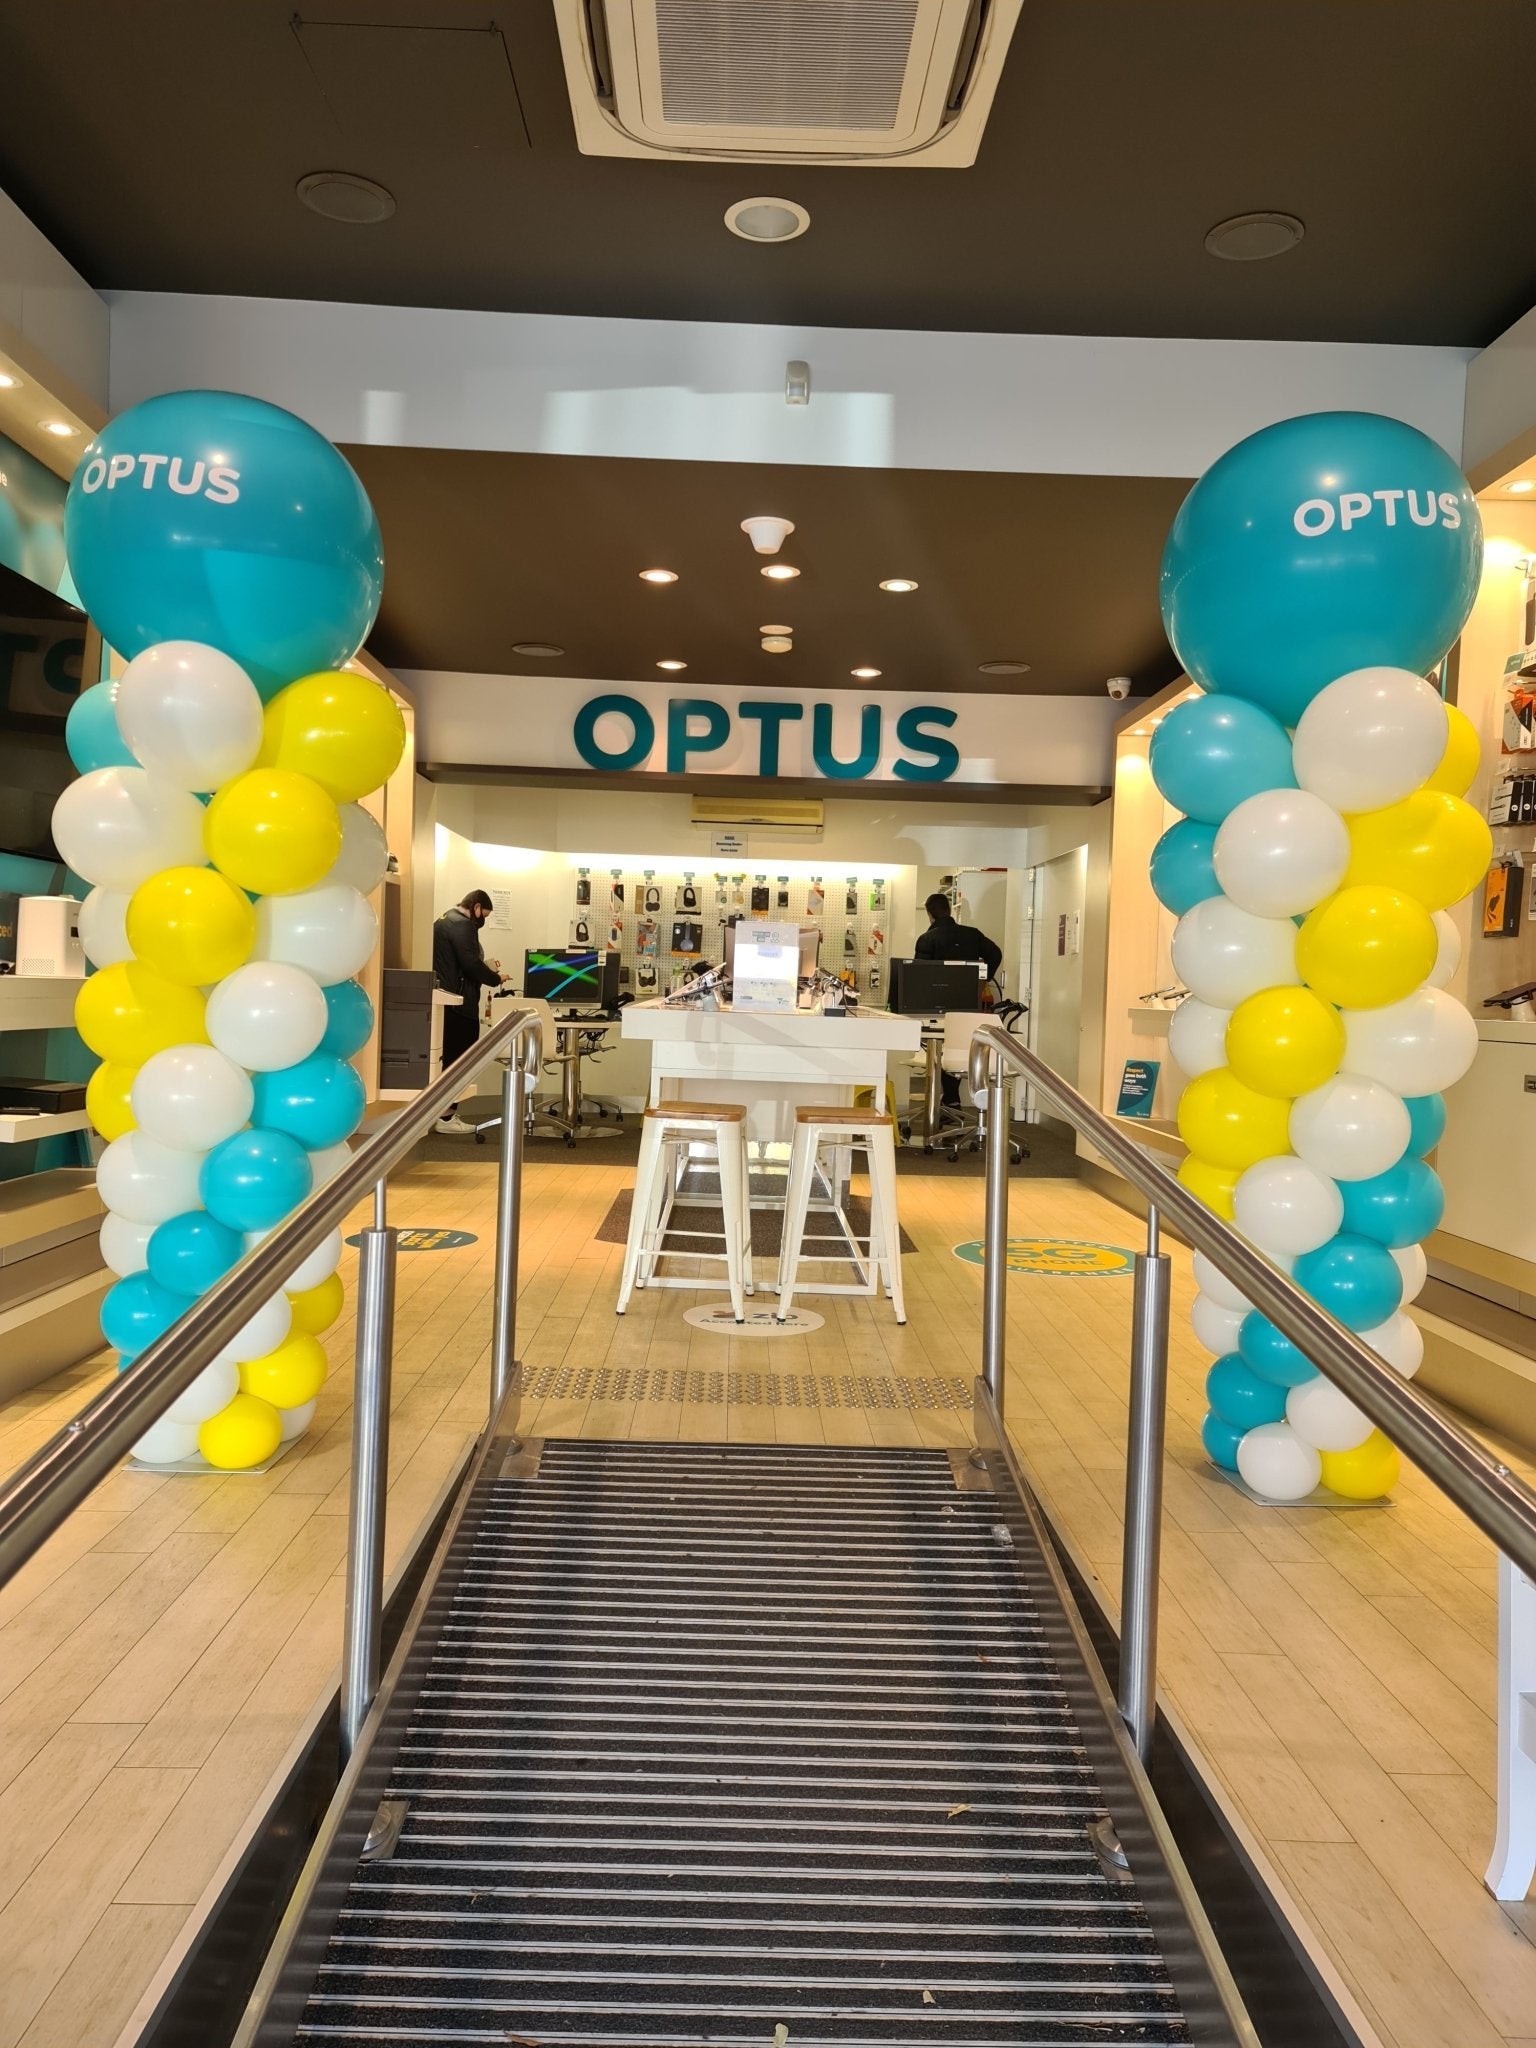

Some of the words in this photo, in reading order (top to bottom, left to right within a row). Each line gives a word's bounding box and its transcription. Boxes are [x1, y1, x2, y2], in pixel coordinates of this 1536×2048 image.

[82, 454, 240, 505] OPTUS
[1293, 489, 1462, 537] OPTUS
[573, 694, 960, 783] OPTUS
